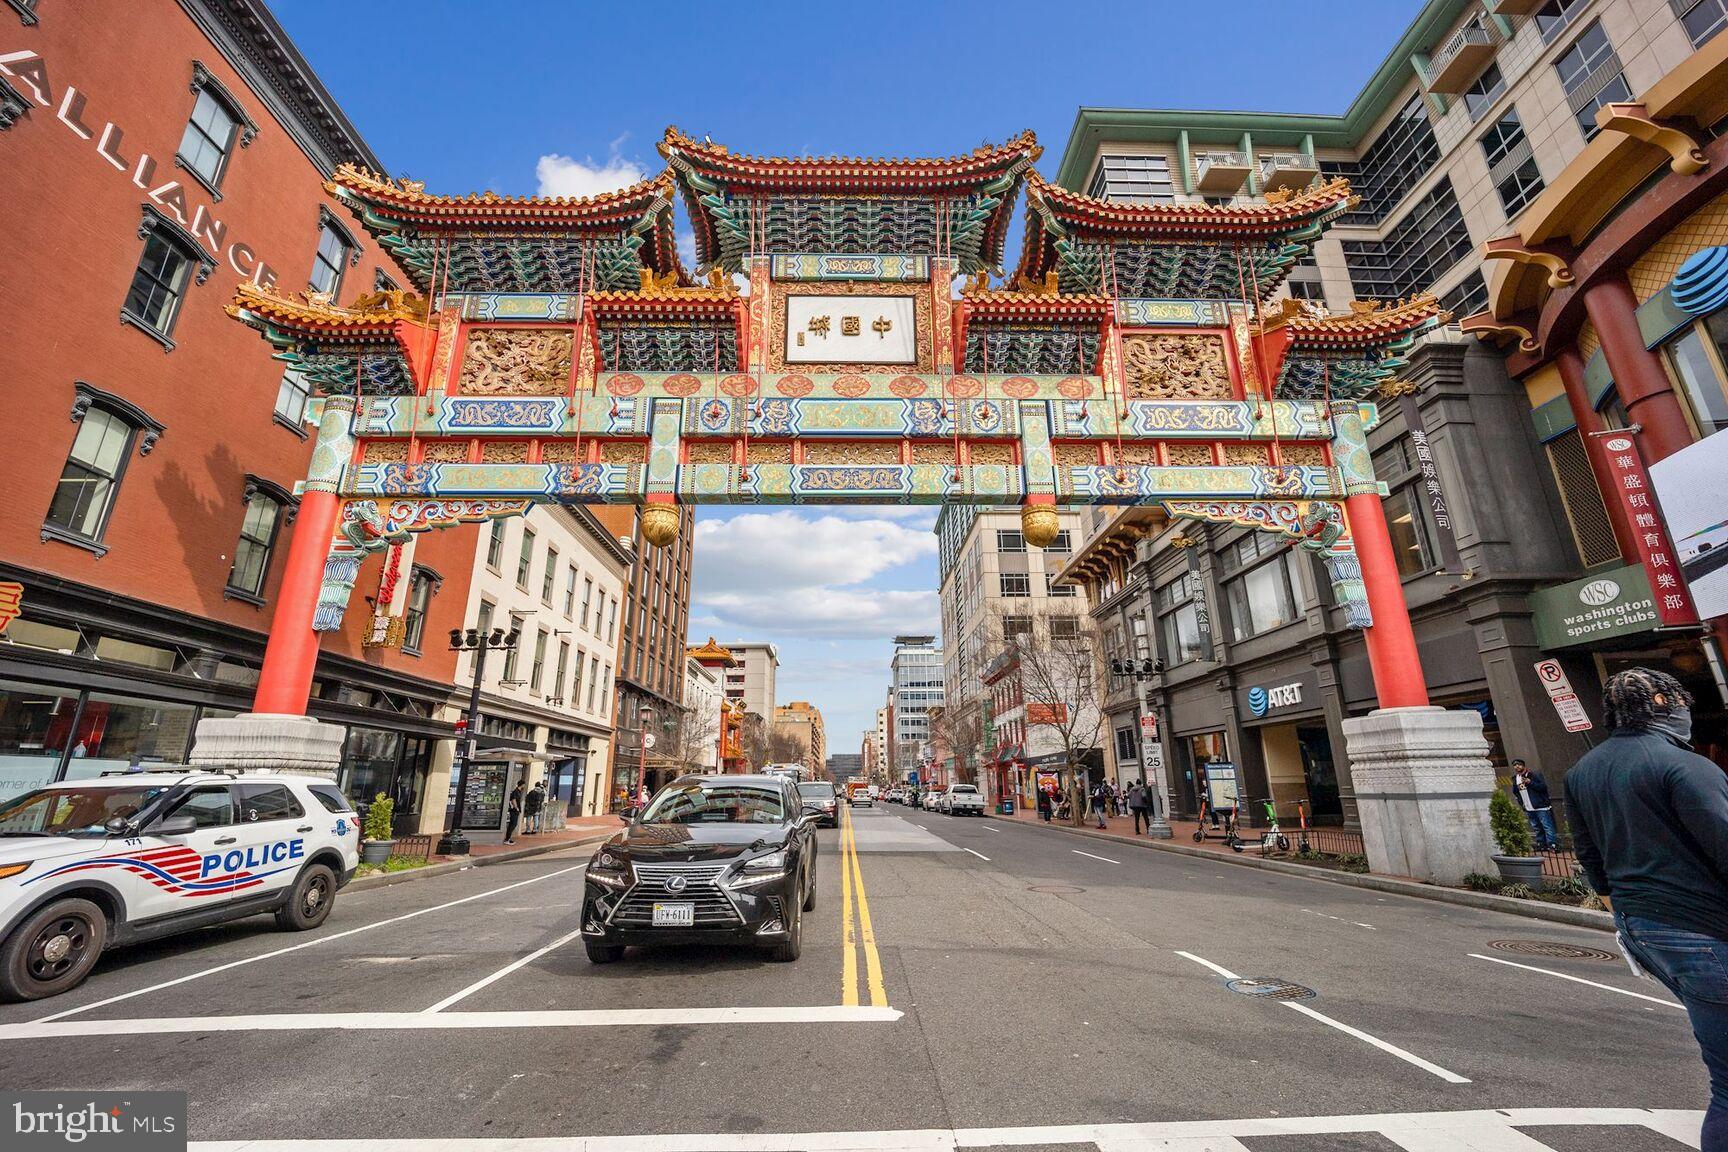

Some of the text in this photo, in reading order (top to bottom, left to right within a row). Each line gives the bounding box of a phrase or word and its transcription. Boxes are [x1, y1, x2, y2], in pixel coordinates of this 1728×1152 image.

[0, 50, 279, 294] ALLIANCE
[1412, 430, 1451, 530] 美國娛樂公司
[1615, 455, 1684, 610] 華盛頓體育俱樂部
[1583, 582, 1615, 603] WSC
[1563, 599, 1652, 625] washington
[1567, 611, 1656, 637] sports clubs
[1268, 682, 1304, 709] AT&T
[1146, 757, 1161, 766] 25
[125, 837, 142, 847] 171
[200, 838, 305, 878] POLICE
